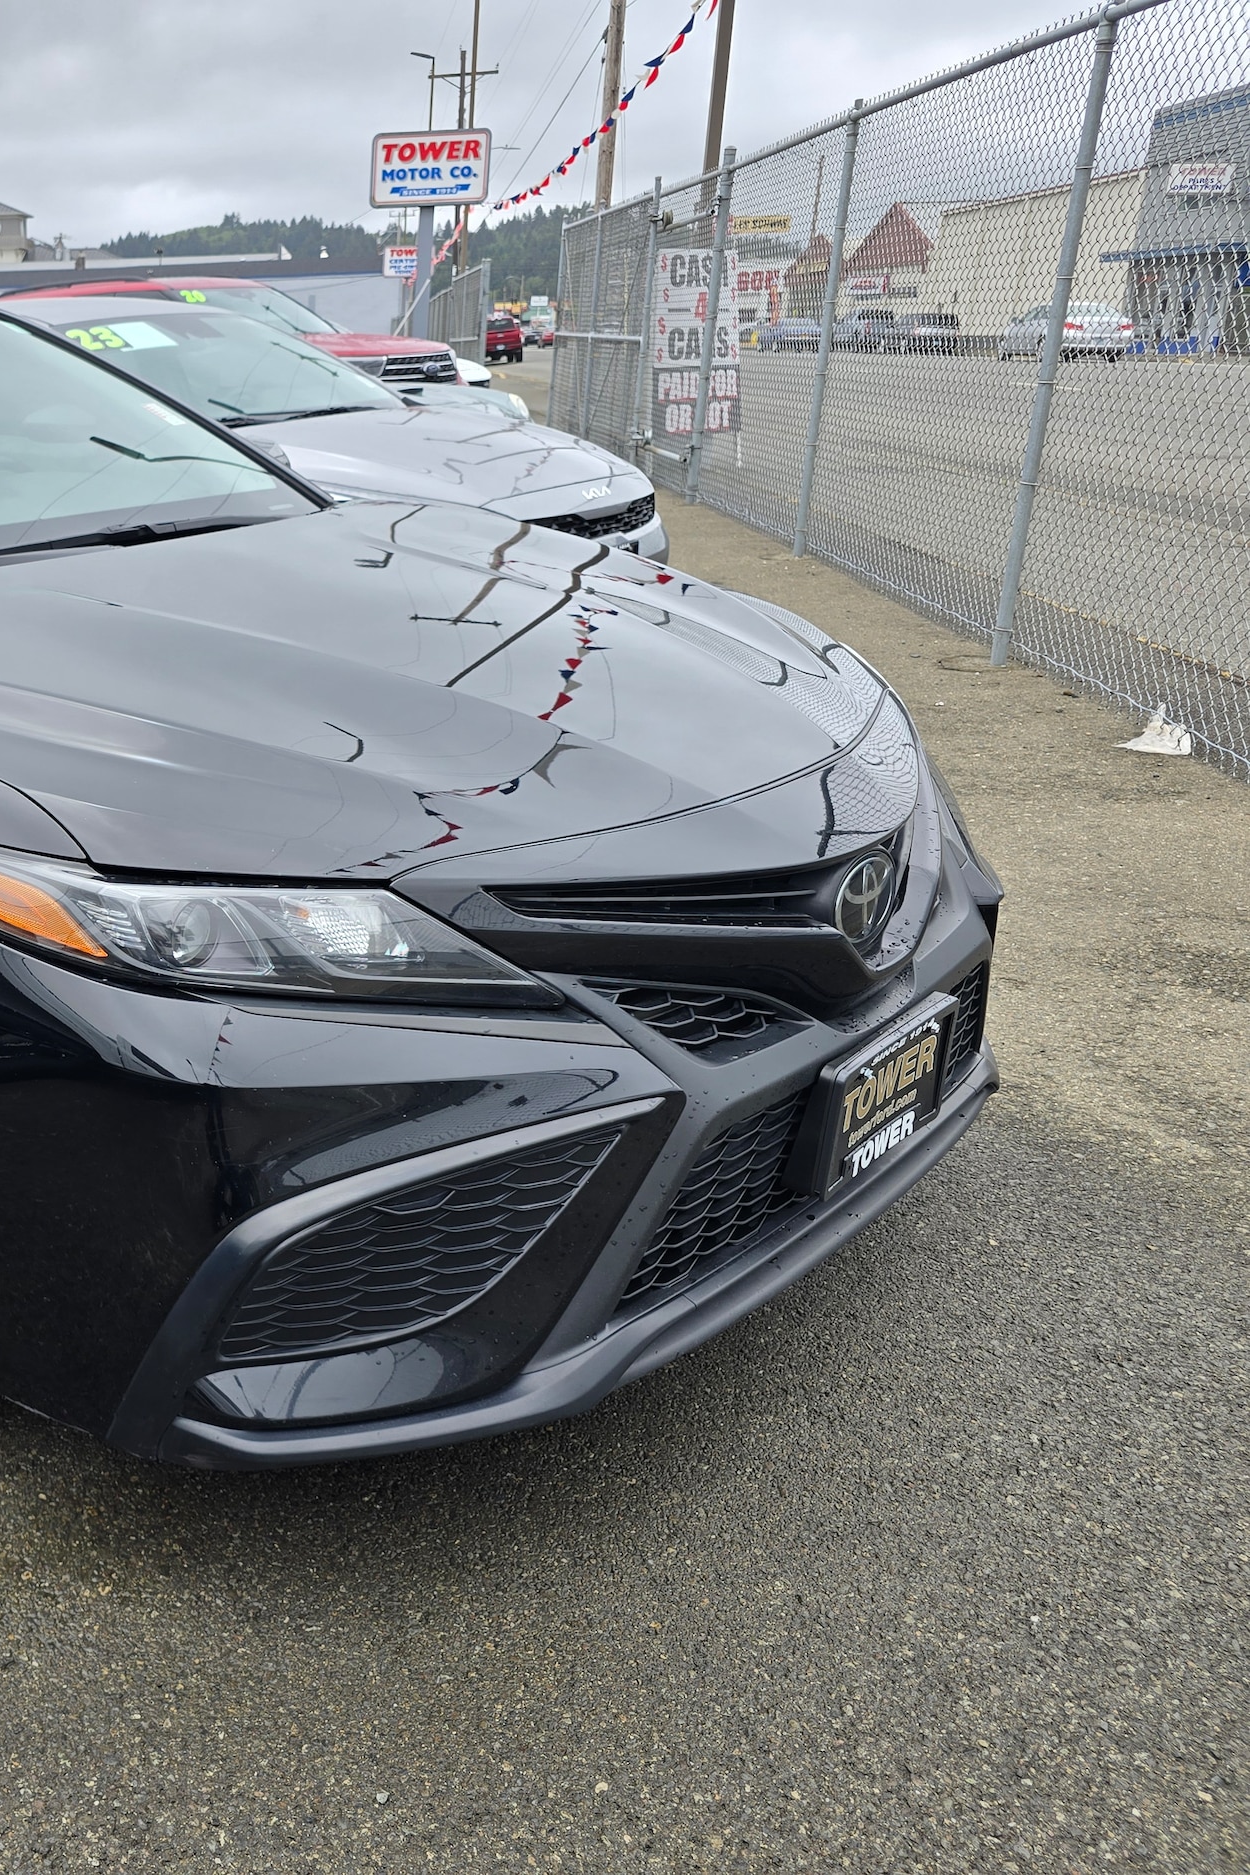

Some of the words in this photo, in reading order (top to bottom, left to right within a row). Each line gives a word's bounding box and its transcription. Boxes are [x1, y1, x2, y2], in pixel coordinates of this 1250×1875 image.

[382, 140, 482, 164] TOWER
[381, 167, 443, 182] MOTOR
[450, 165, 478, 179] CO.
[1181, 167, 1227, 177] TOWER
[403, 188, 432, 197] SINCE
[390, 248, 417, 257] TOW
[179, 289, 207, 303] 20
[65, 326, 127, 351] 23
[665, 403, 693, 433] OR
[871, 1036, 908, 1067] SINCE
[842, 1034, 938, 1134] TOWER
[848, 1088, 918, 1148] towerford.com
[851, 1110, 916, 1178] TOWER
